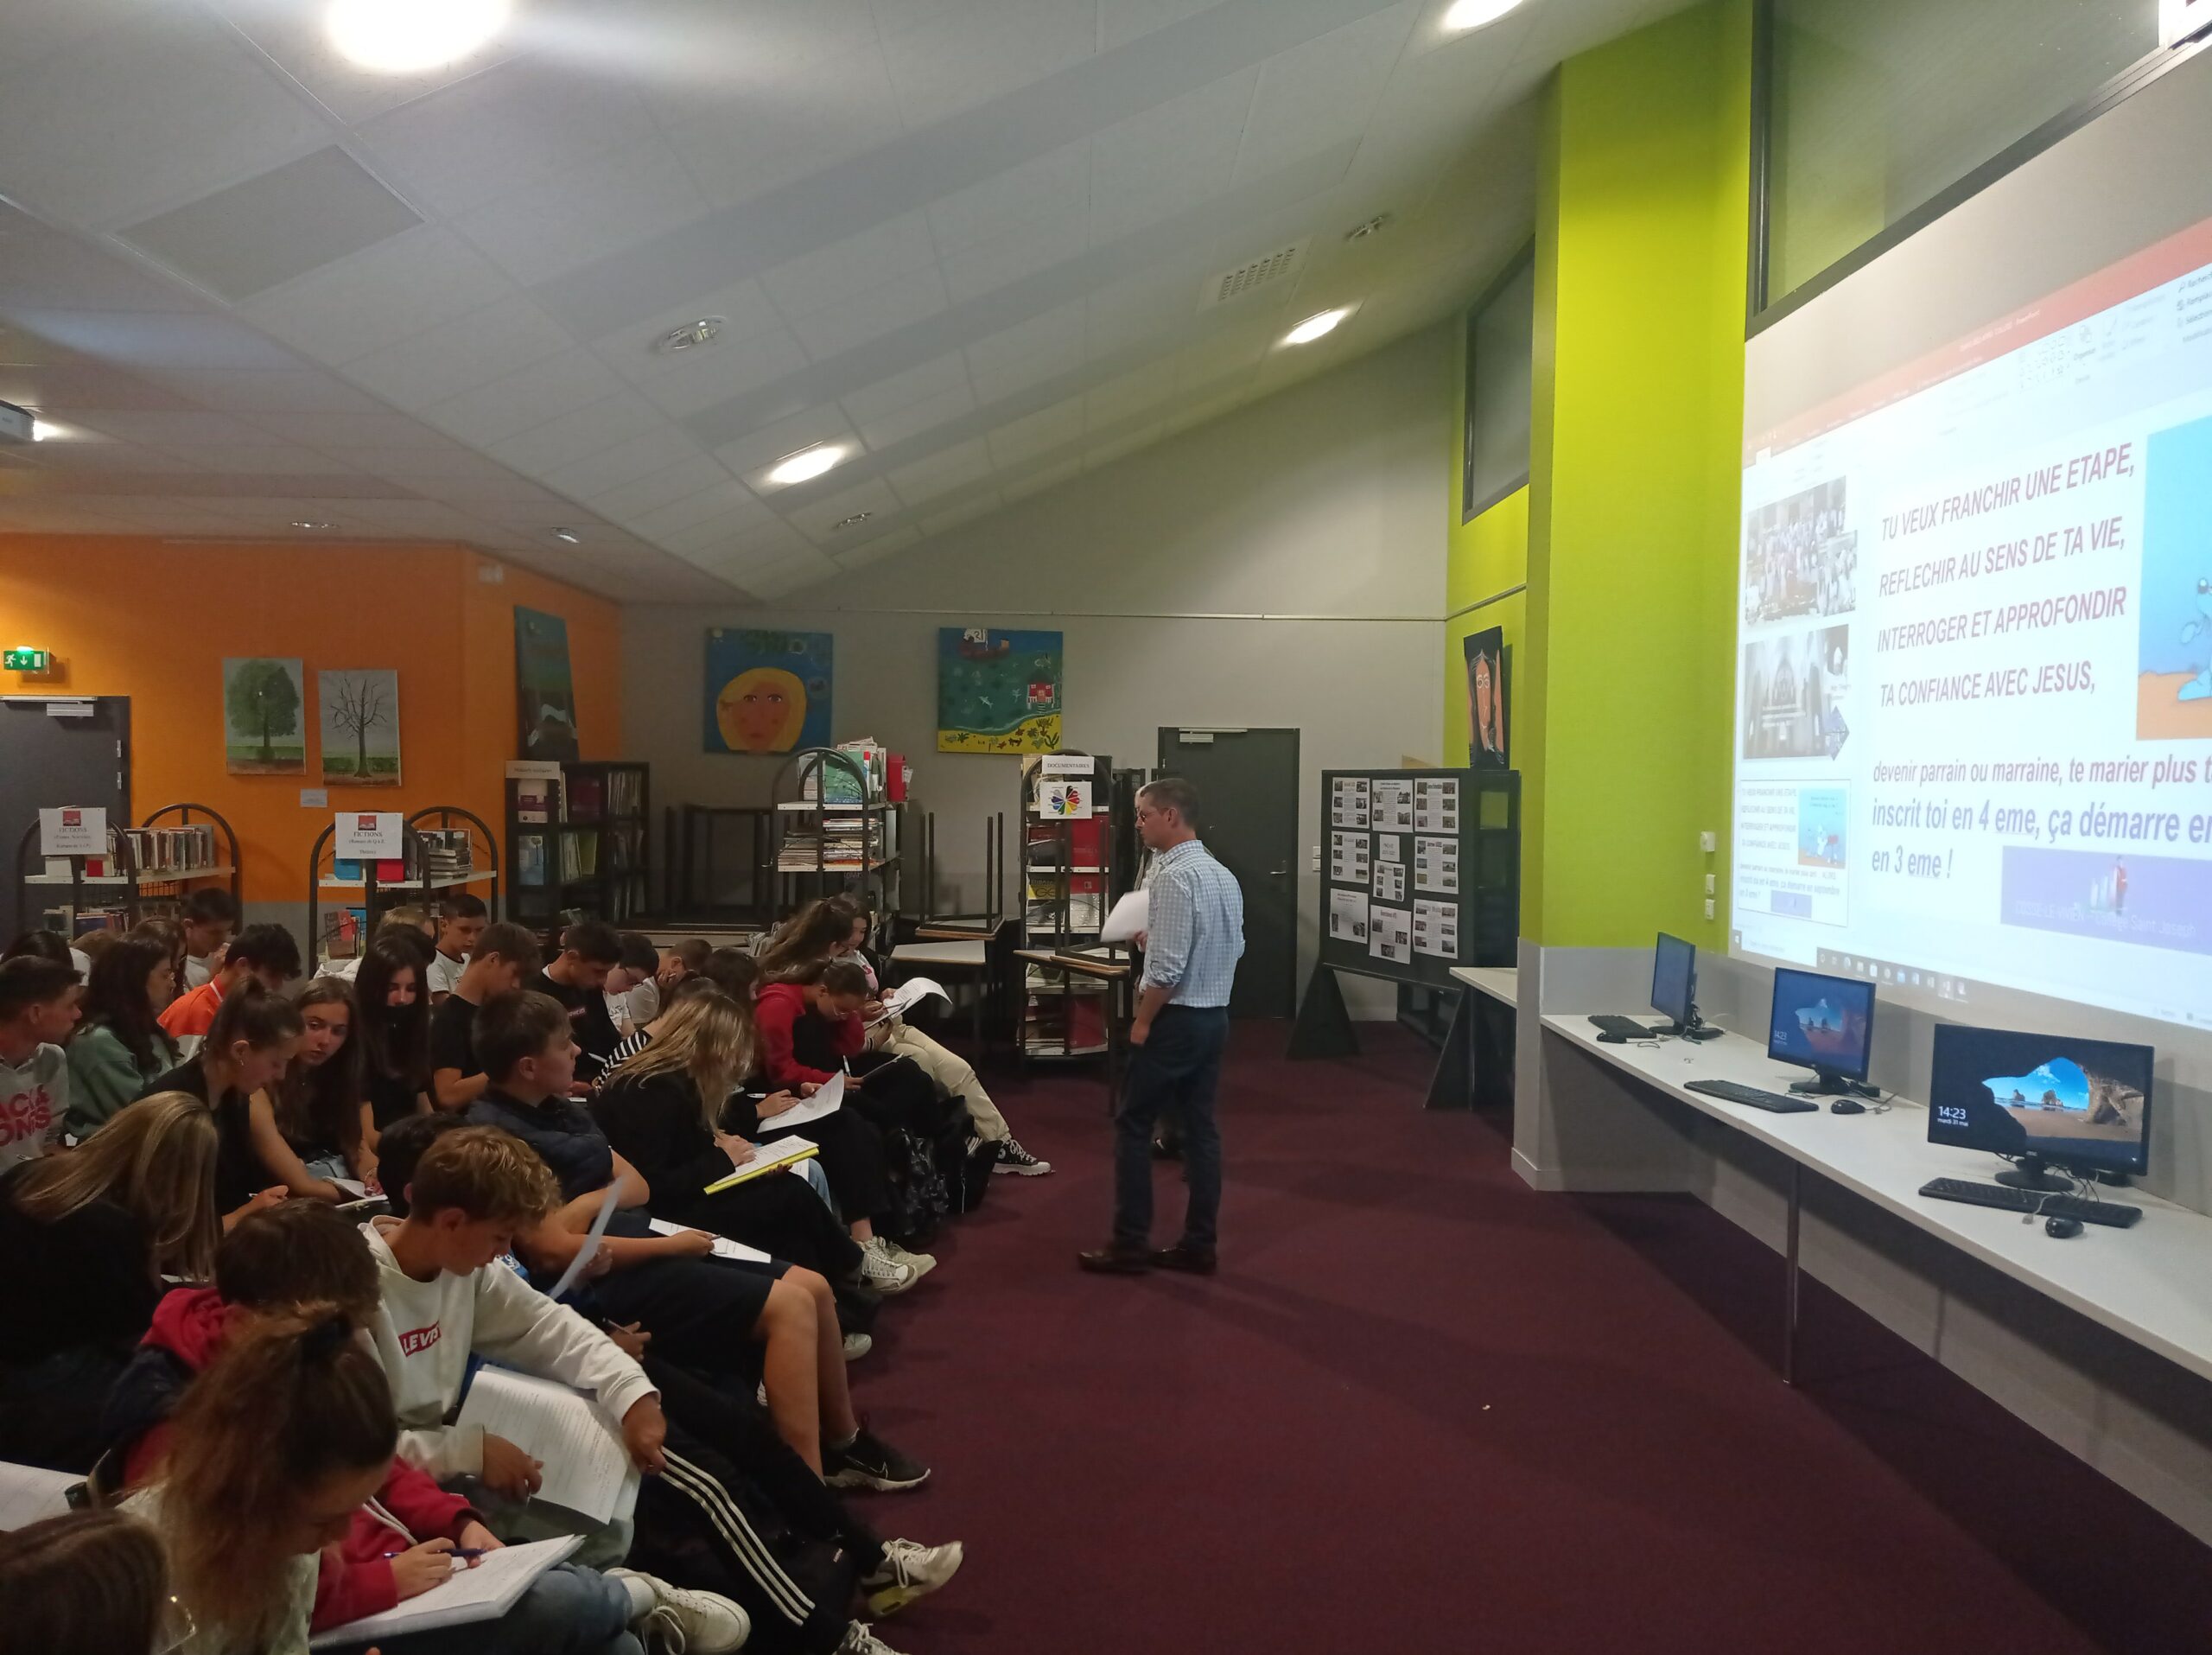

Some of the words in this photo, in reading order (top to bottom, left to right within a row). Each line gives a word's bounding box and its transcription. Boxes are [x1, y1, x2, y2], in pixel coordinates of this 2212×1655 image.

[1882, 514, 1898, 541] TU
[1902, 501, 1939, 536] VEUX
[1942, 477, 2020, 525] FRANCHIR
[2025, 463, 2063, 500] UNE
[2066, 442, 2135, 489] ETAPE,
[1878, 557, 1956, 597] REFLECHIR
[1958, 550, 1981, 580] AU
[1984, 538, 2029, 574] SENS
[2032, 532, 2058, 563] DE
[2063, 525, 2083, 557] TA
[2090, 515, 2125, 551] VIE,
[1877, 614, 1967, 652] INTERROGER
[1971, 609, 1993, 639] ET
[1993, 586, 2127, 634] APPROFONDIR
[1880, 684, 1895, 708] TA
[1898, 672, 1982, 706] CONFIANCE
[1984, 668, 2028, 698] AVEC
[2032, 660, 2095, 695] JESUS,
[1873, 760, 1917, 782] devenir
[1920, 759, 1967, 787] parrain
[1970, 762, 1989, 782] ou
[1992, 757, 2063, 786] marraine,
[2069, 757, 2084, 783] te
[2089, 754, 2149, 783] marier
[2152, 754, 2197, 789] plus
[1872, 797, 1921, 828] inscrit
[1926, 799, 1948, 829] toi
[1952, 806, 1974, 830] en
[1979, 799, 1990, 831] 4
[1995, 807, 2040, 841] eme,
[2049, 809, 2072, 843] ça
[2079, 802, 2180, 842] démarre
[1872, 850, 1890, 872] en
[1894, 844, 1904, 874] 3
[1907, 852, 1942, 877] eme
[1946, 848, 1953, 879] !
[1938, 1106, 1967, 1120] 14:23
